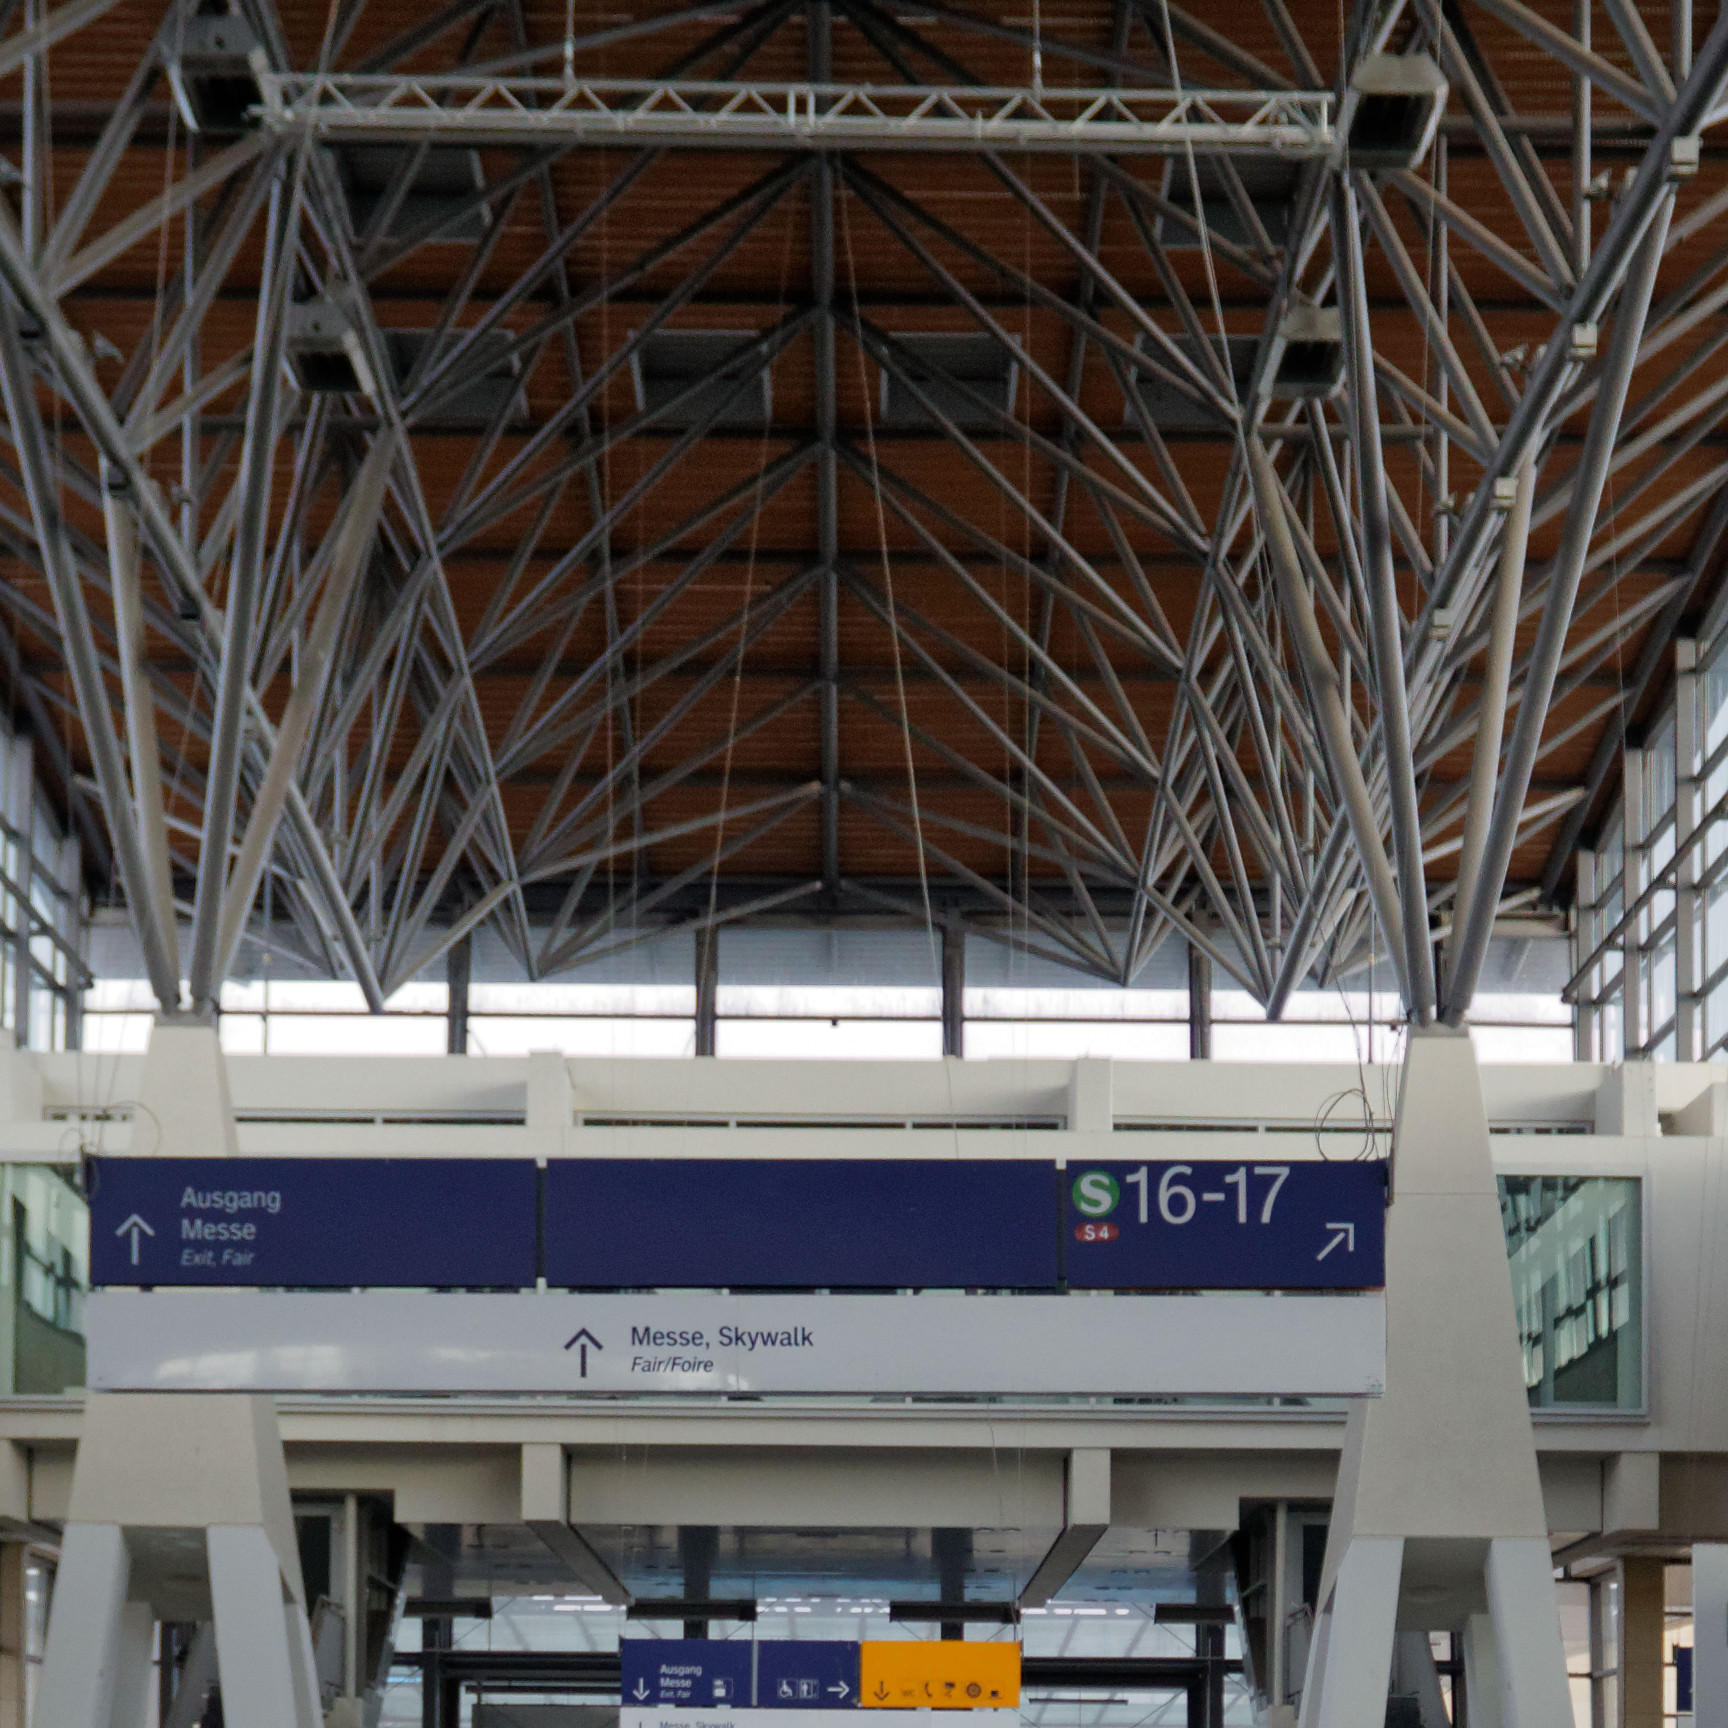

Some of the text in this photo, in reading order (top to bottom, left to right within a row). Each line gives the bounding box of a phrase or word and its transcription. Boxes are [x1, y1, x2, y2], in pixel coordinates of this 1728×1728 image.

[180, 1186, 282, 1214] Ausgang
[1079, 1165, 1291, 1225] S 16-17
[180, 1217, 257, 1241] Messe
[221, 1248, 256, 1266] Fair
[631, 1325, 814, 1351] Messe, Skywalk
[630, 1355, 715, 1373] Fair/Foire
[660, 1664, 702, 1676] Ausgang
